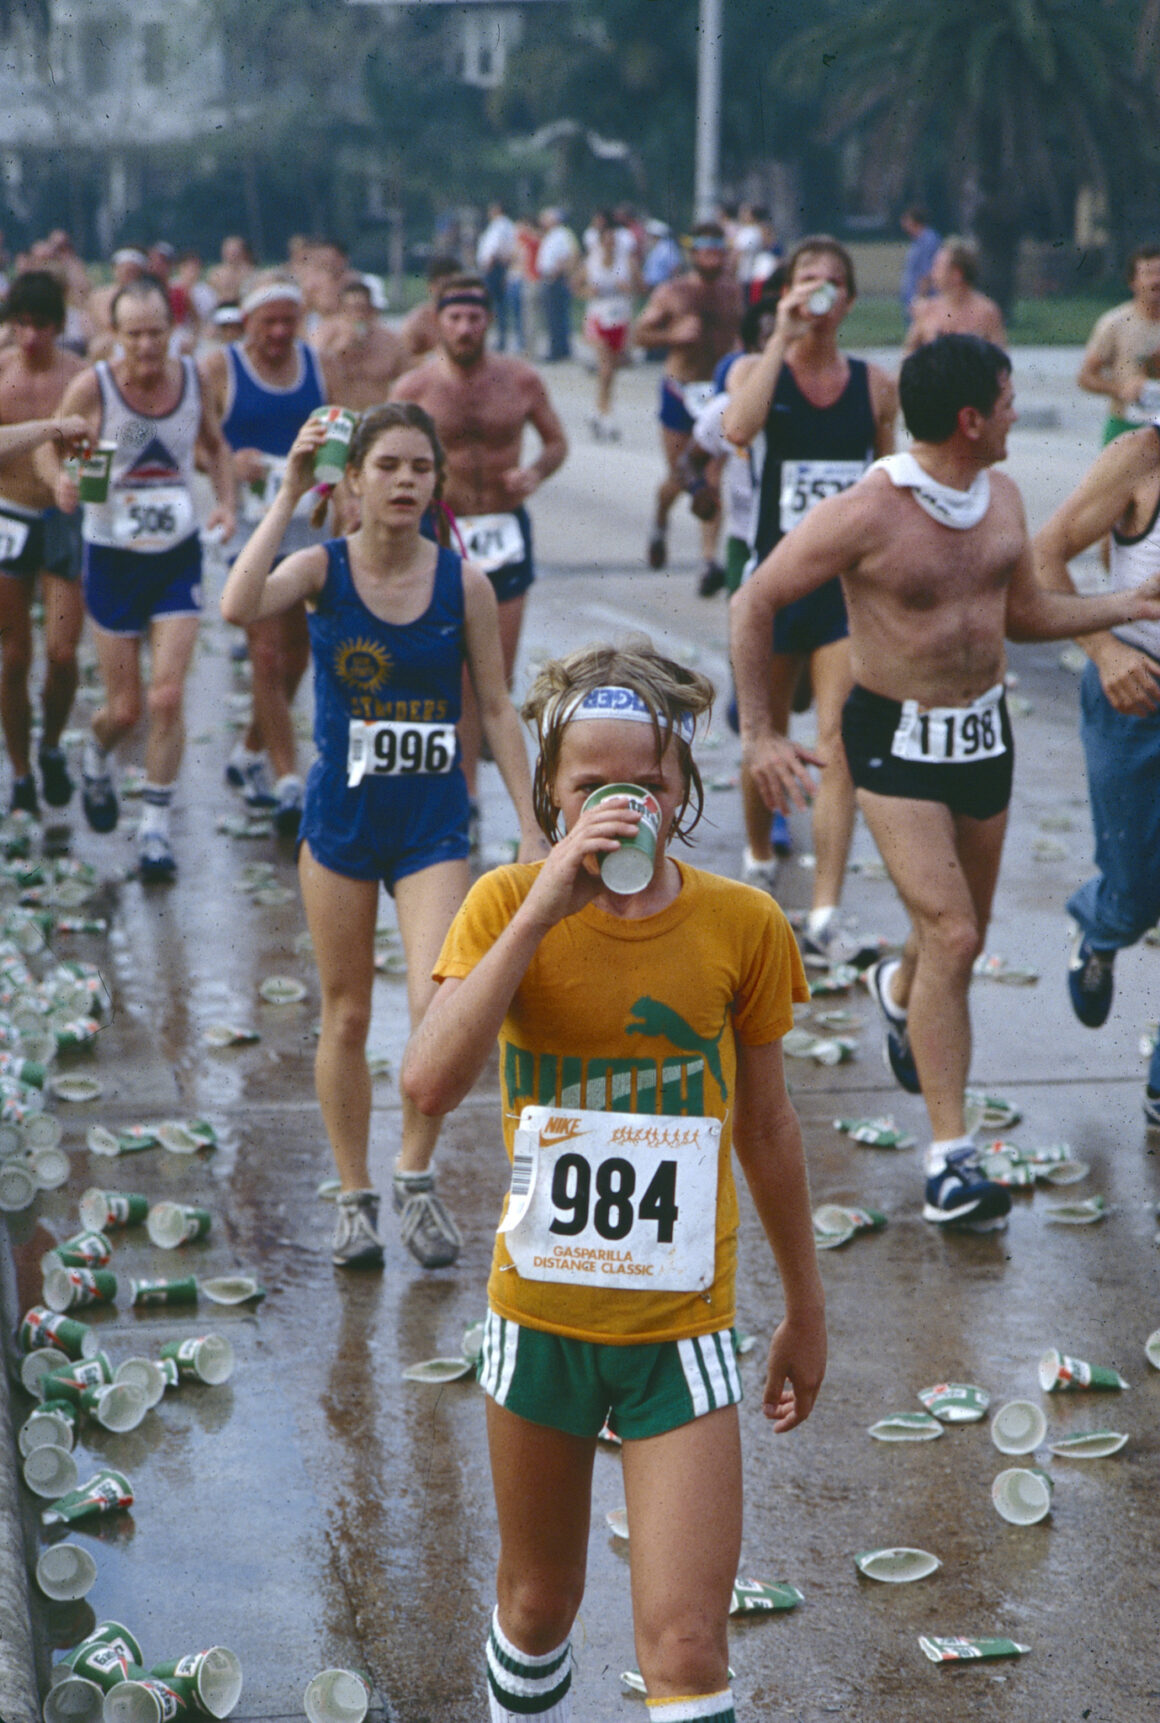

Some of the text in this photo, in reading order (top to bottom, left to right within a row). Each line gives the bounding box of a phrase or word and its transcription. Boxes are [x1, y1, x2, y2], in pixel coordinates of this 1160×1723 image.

[130, 504, 176, 535] 506
[374, 729, 448, 773] 996
[920, 708, 996, 757] 1198
[505, 1041, 705, 1117] PUMA
[544, 1116, 582, 1134] NIKE
[548, 1152, 678, 1243] 984
[533, 1256, 654, 1276] DISTANCE CLASSIC
[553, 1245, 633, 1263] GASPARILLA
